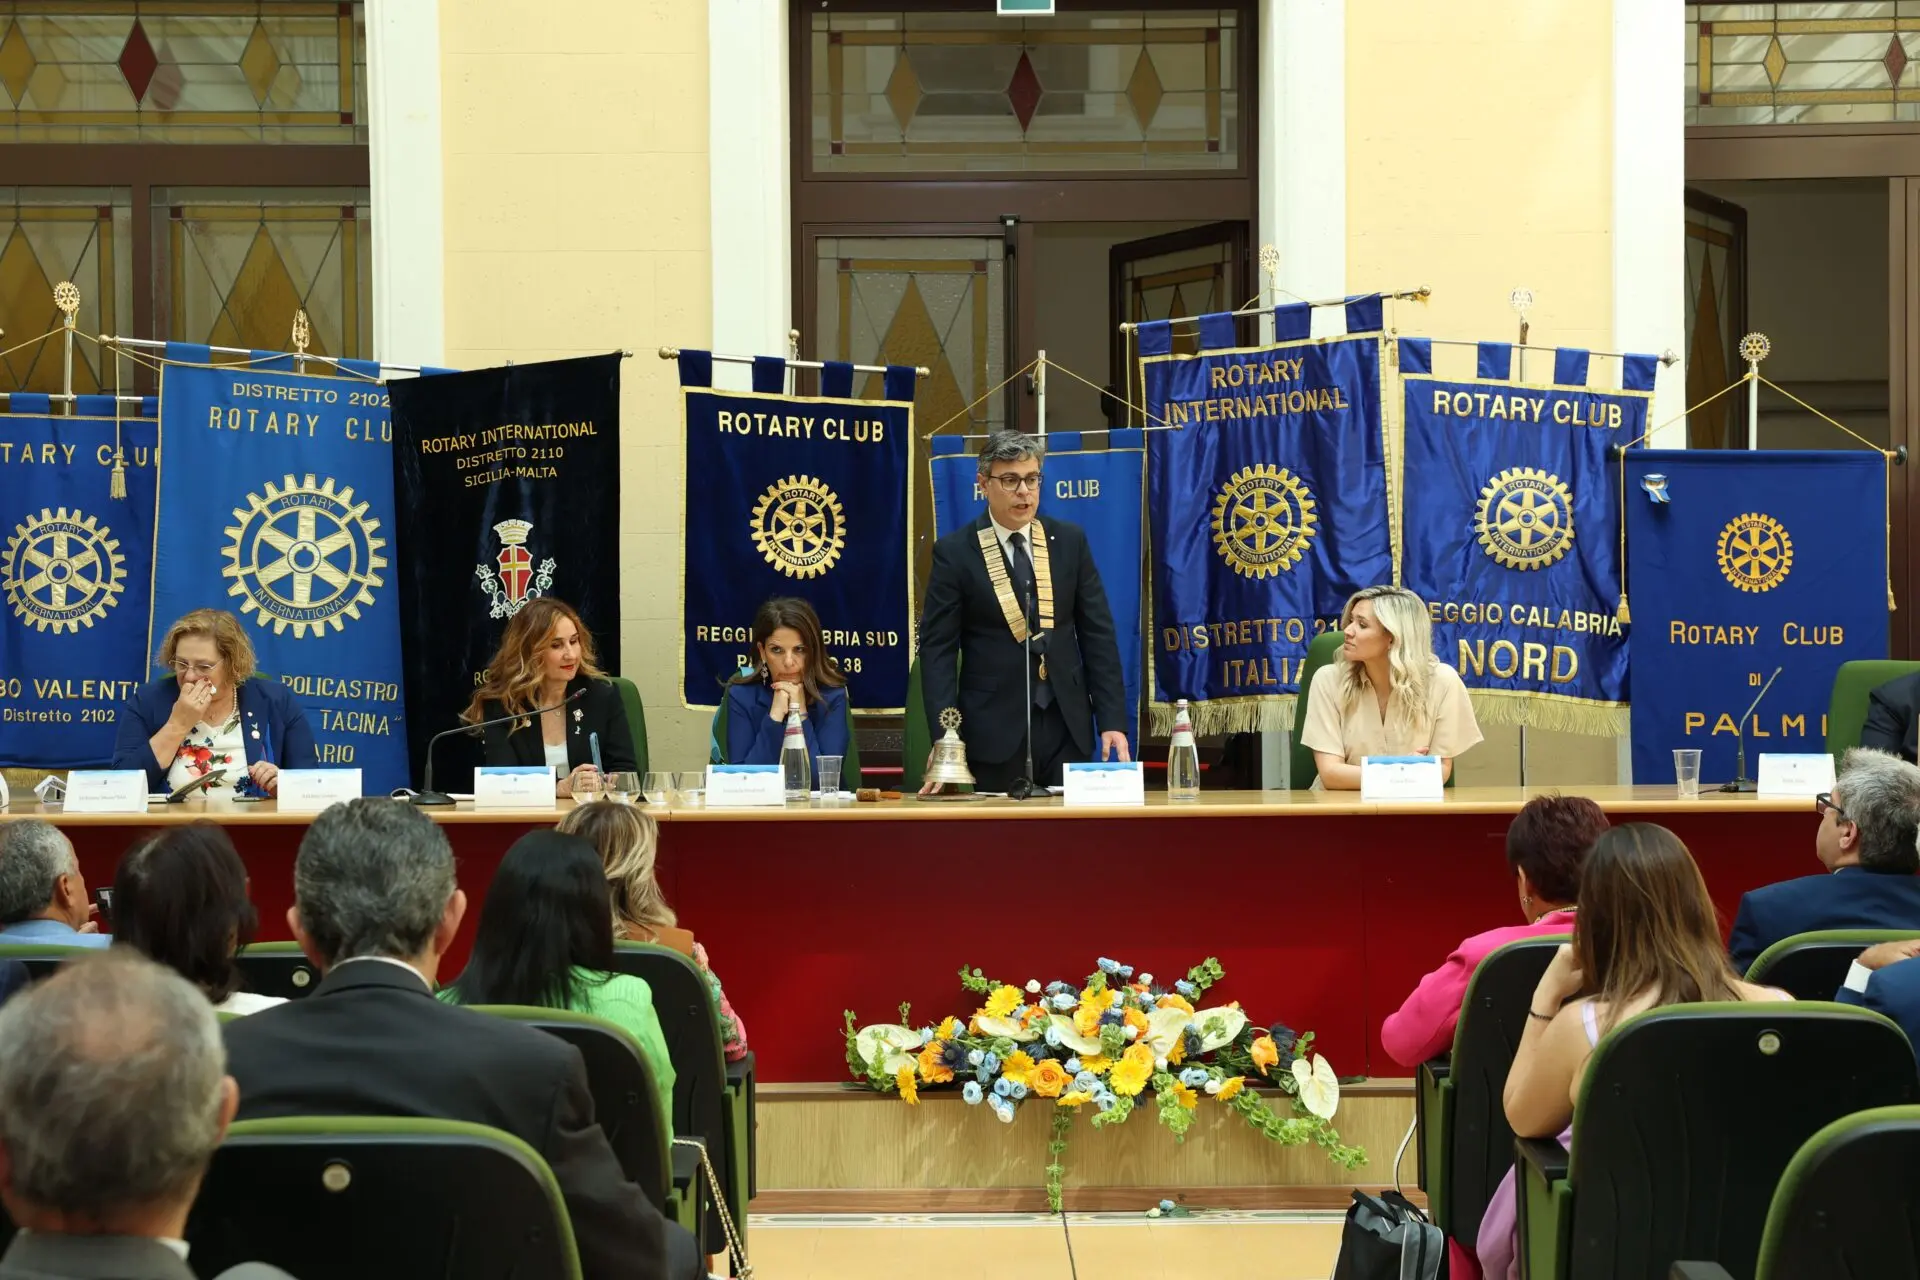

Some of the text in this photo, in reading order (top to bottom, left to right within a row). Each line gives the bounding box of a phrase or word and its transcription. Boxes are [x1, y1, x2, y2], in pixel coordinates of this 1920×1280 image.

[1211, 357, 1304, 389] ROTARY
[233, 383, 391, 408] DISTRETTO 2102
[1164, 387, 1349, 424] INTERNATIONAL
[1433, 390, 1622, 428] ROTARY CLUB
[209, 406, 393, 442] ROTARY CLU
[718, 411, 884, 443] ROTARY CLUB
[421, 421, 598, 454] ROTARY INTERNATIONAL
[97, 444, 158, 467] CLU
[456, 447, 564, 470] DISTRETTO 2110
[464, 466, 558, 488] SICILIA-MALTA
[1056, 479, 1100, 499] CLUB
[1239, 479, 1281, 494] ROTARY
[1509, 480, 1550, 492] ROTARY
[280, 494, 337, 510] ROTARY
[784, 489, 822, 503] ROTARY
[39, 524, 84, 535] ROTARY
[768, 539, 830, 566] INTERNATIONAL
[1229, 536, 1297, 563] INTERNATIONAL
[1491, 531, 1561, 557] INTERNATIONAL
[21, 596, 97, 619] INTERNATIONAL
[253, 587, 350, 620] INTERNATIONAL
[1429, 602, 1622, 637] EGGIO CALABRIA
[696, 625, 753, 643] REGGI
[866, 631, 898, 647] SUD
[1163, 617, 1305, 652] DISTRETTO
[843, 657, 862, 673] 38
[1458, 639, 1579, 683] NORD
[281, 675, 398, 701] POLICASTRO
[1748, 673, 1761, 686] DI
[3, 708, 115, 722] Distretto 2102
[1685, 712, 1827, 737] PALMI
